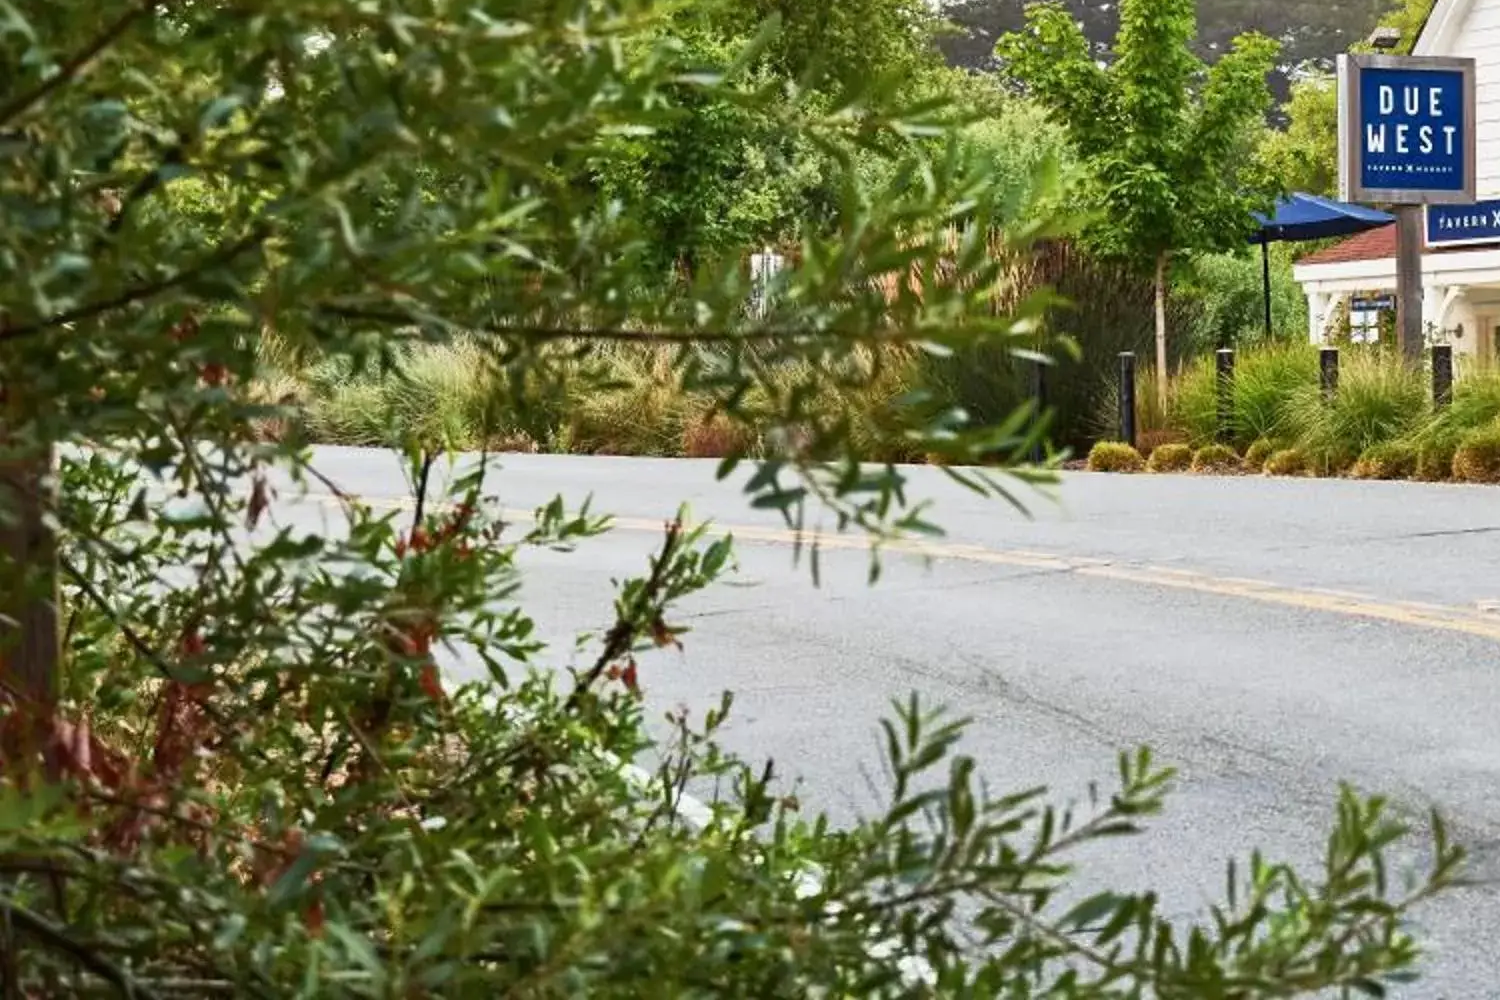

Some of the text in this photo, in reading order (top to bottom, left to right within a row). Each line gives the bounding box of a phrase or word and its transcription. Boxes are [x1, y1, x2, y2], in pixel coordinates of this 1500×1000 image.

[1379, 85, 1443, 117] DUE
[1367, 123, 1456, 155] WEST
[1440, 214, 1487, 229] TAVERN
